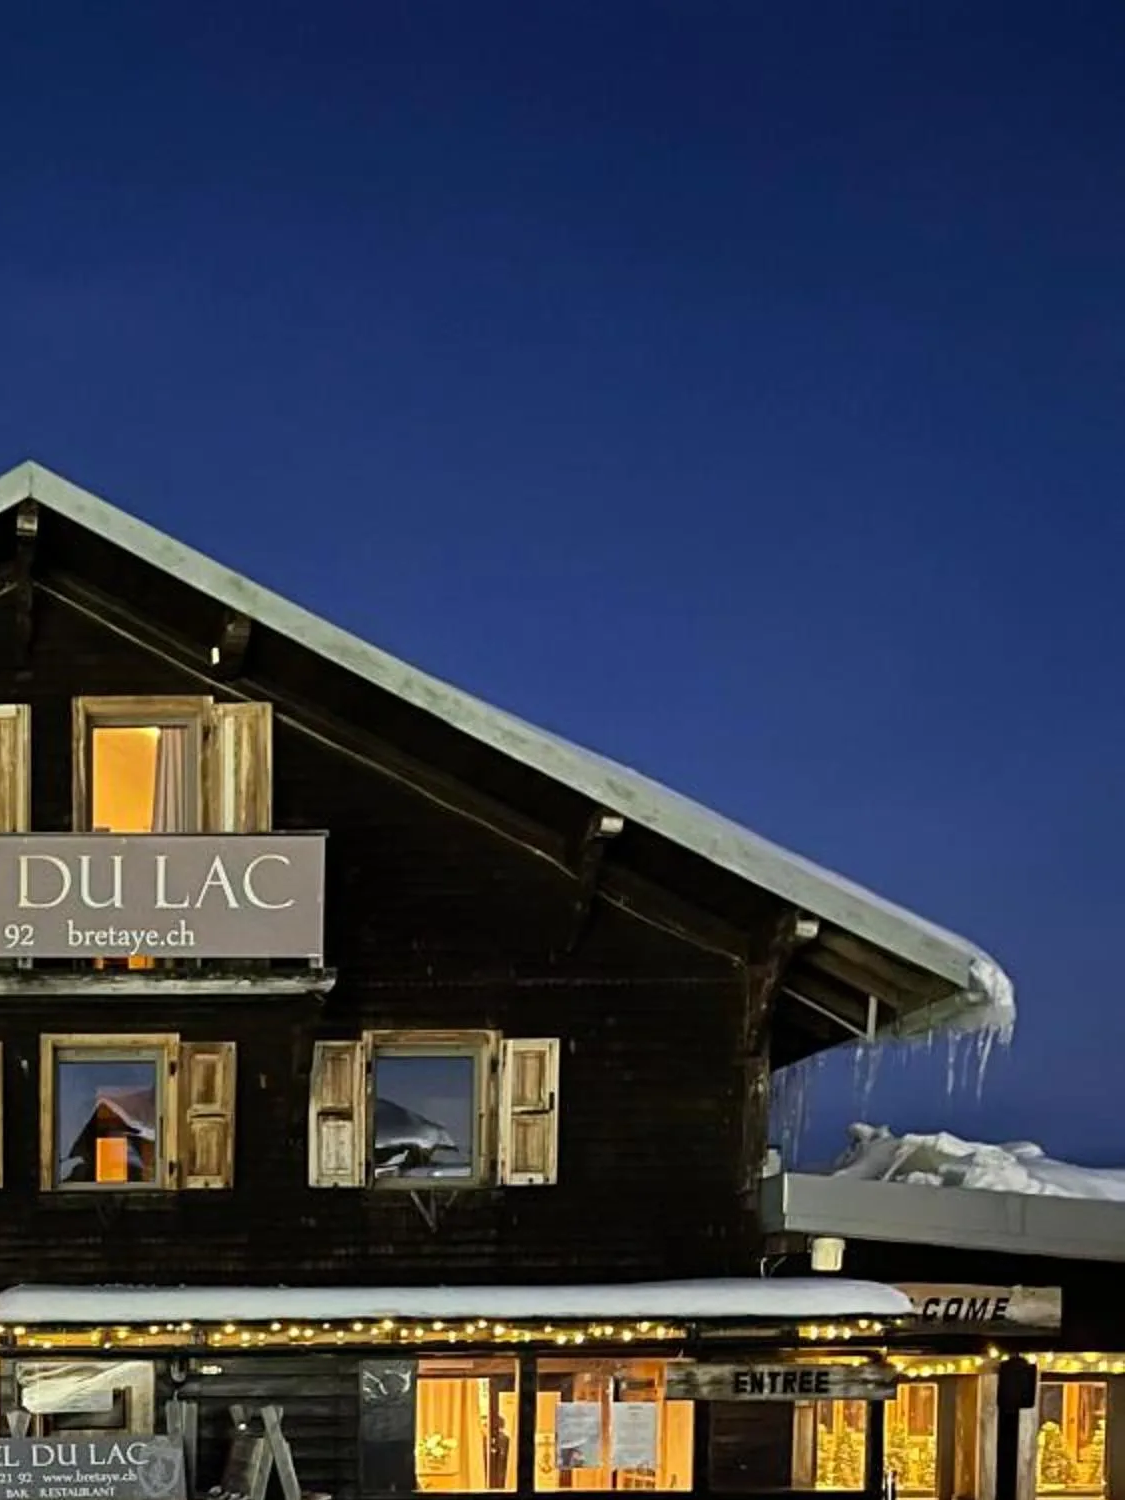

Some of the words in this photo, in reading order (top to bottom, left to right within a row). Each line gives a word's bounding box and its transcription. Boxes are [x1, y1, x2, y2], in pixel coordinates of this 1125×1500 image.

[17, 854, 125, 909] DU
[154, 854, 295, 909] LAC
[3, 924, 35, 947] 92
[67, 922, 195, 954] bretaye.ch
[922, 1297, 1011, 1321] COME
[733, 1370, 830, 1394] ENTREE
[31, 1443, 77, 1467] DU
[89, 1442, 150, 1466] LAC
[17, 1472, 33, 1485] 92
[42, 1469, 139, 1486] www.bretaye.ch
[6, 1488, 29, 1499] BAR
[39, 1486, 116, 1498] RESTAURANT
